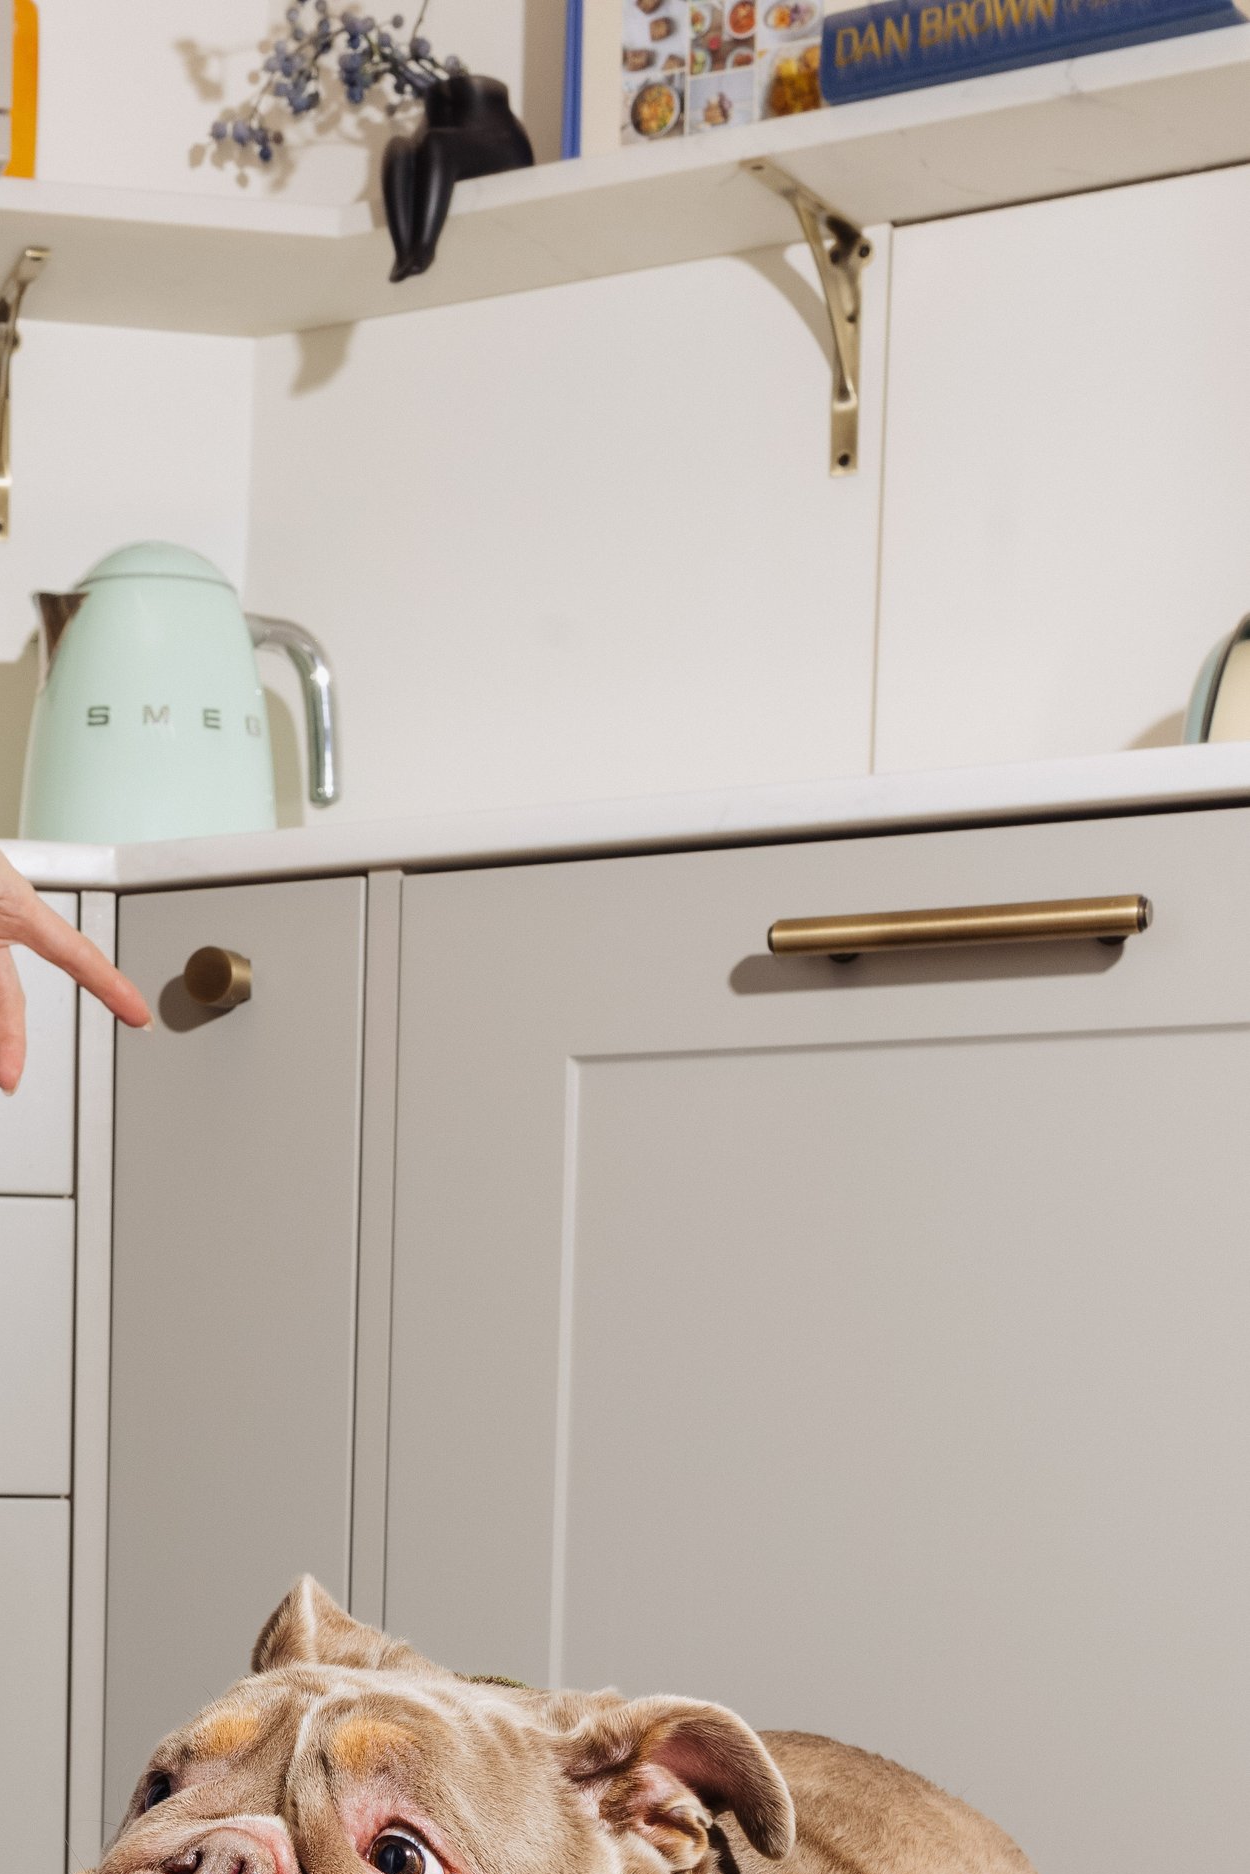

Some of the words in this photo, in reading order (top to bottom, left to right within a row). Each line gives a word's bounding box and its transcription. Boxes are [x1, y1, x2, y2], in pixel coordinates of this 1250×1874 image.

[834, 14, 911, 68] DAN
[918, 0, 1058, 49] BROWN
[86, 705, 262, 738] SMEG
